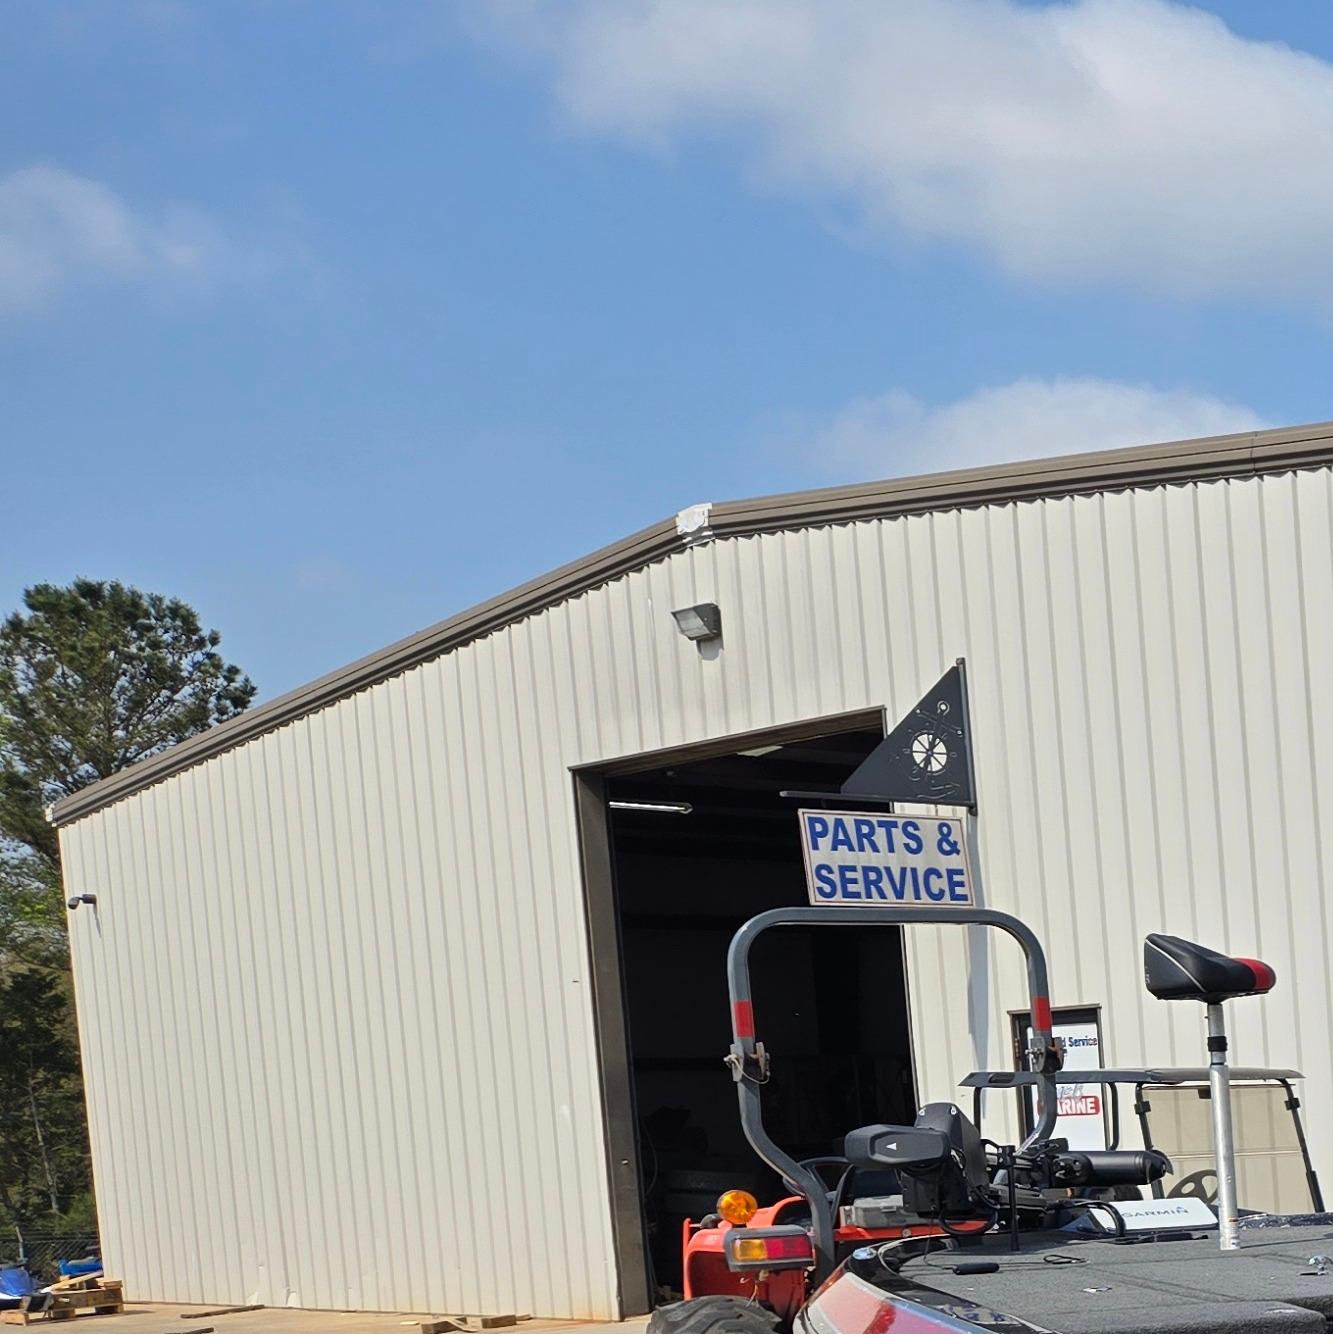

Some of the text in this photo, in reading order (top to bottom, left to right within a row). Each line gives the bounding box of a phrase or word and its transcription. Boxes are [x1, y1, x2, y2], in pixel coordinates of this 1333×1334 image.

[807, 816, 960, 856] PARTS &
[814, 863, 969, 902] SERVICE
[1068, 1035, 1098, 1048] Service
[1056, 1097, 1096, 1115] ARINE
